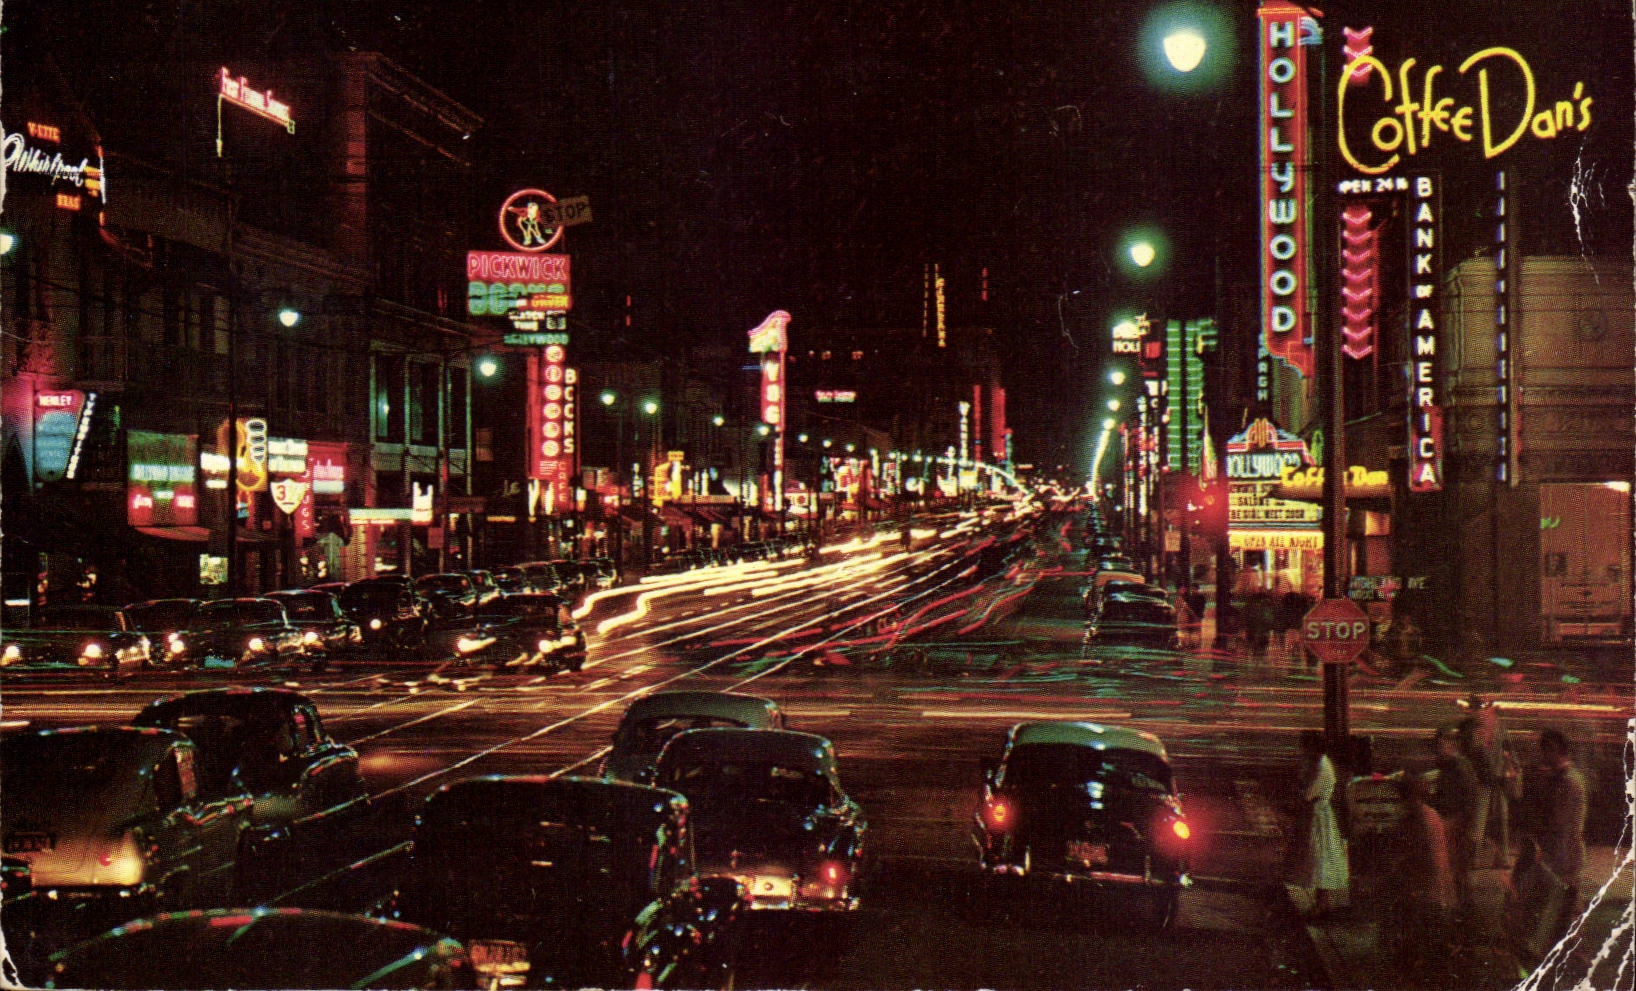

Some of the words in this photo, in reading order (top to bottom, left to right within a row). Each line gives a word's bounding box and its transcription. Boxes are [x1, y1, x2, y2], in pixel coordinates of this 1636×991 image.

[1338, 55, 1472, 174] Coffee
[1459, 47, 1592, 159] Dan's
[1269, 22, 1297, 332] HOLLYWOOD
[1416, 177, 1433, 275] BANK
[467, 254, 566, 280] PICKWICK
[1416, 309, 1436, 483] AMERICA
[1307, 622, 1366, 639] STOP
